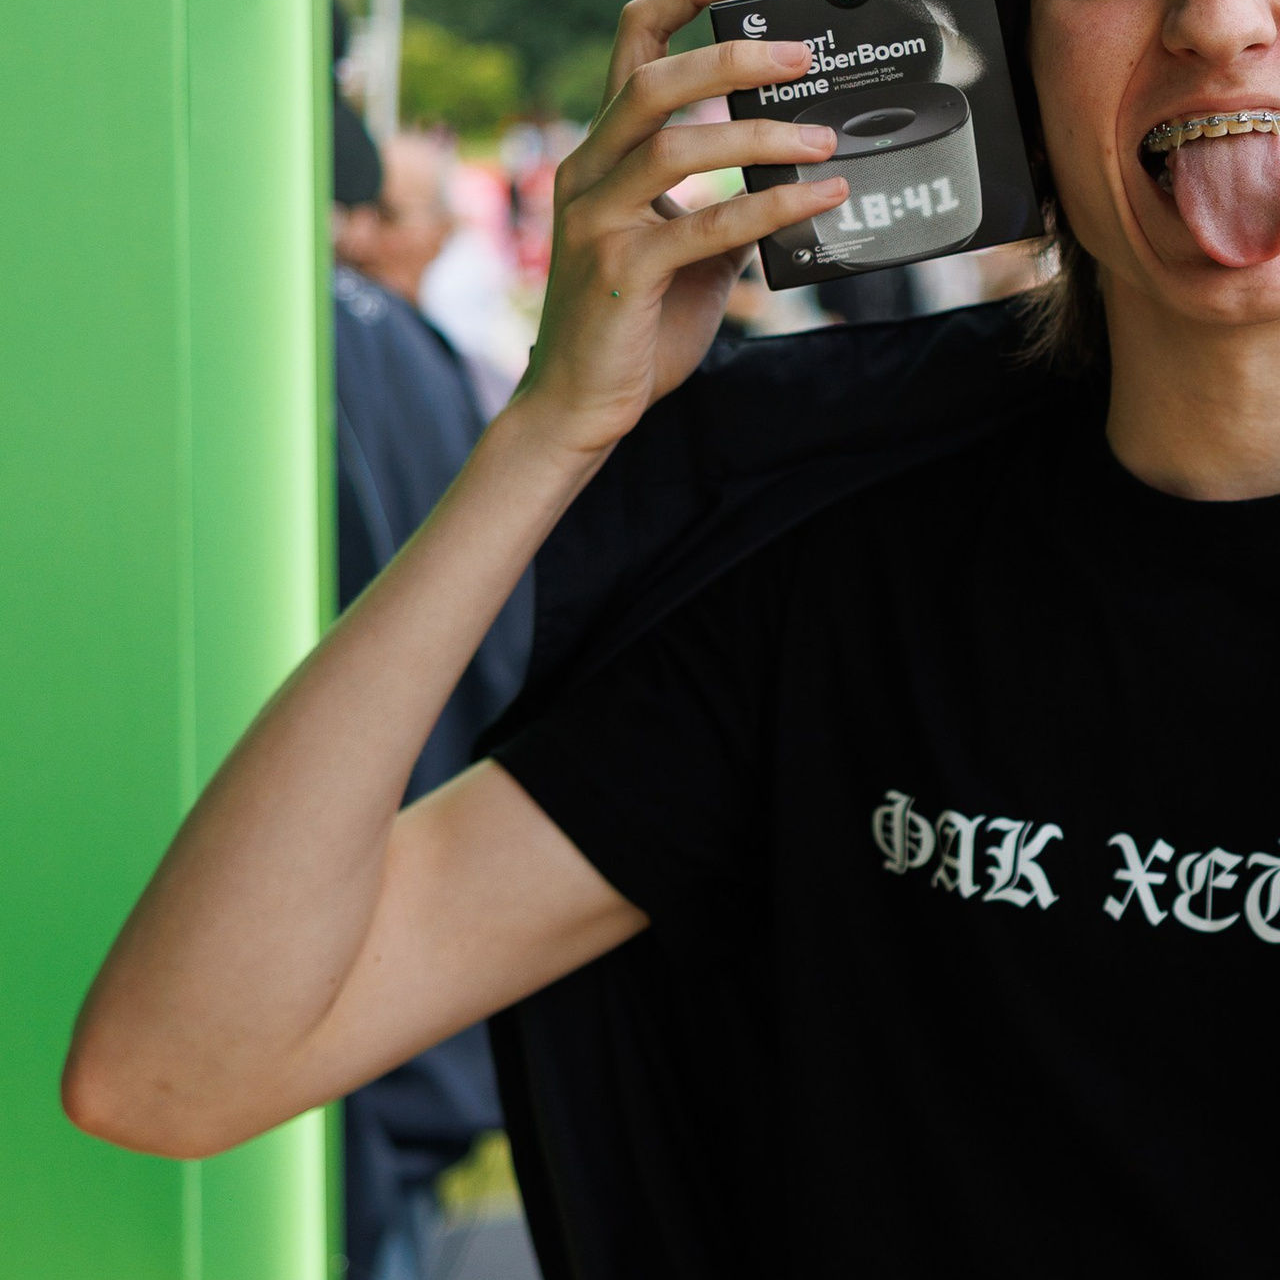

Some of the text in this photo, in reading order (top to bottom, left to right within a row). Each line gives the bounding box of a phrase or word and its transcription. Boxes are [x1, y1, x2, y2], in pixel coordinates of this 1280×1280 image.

[803, 30, 836, 52] от!
[806, 37, 927, 75] SberBoom
[880, 66, 896, 75] звук
[758, 77, 829, 106] Home
[840, 77, 879, 89] поддержка
[880, 72, 904, 82] Zigbee
[837, 176, 961, 231] 18:41
[872, 789, 1064, 910] ФАК
